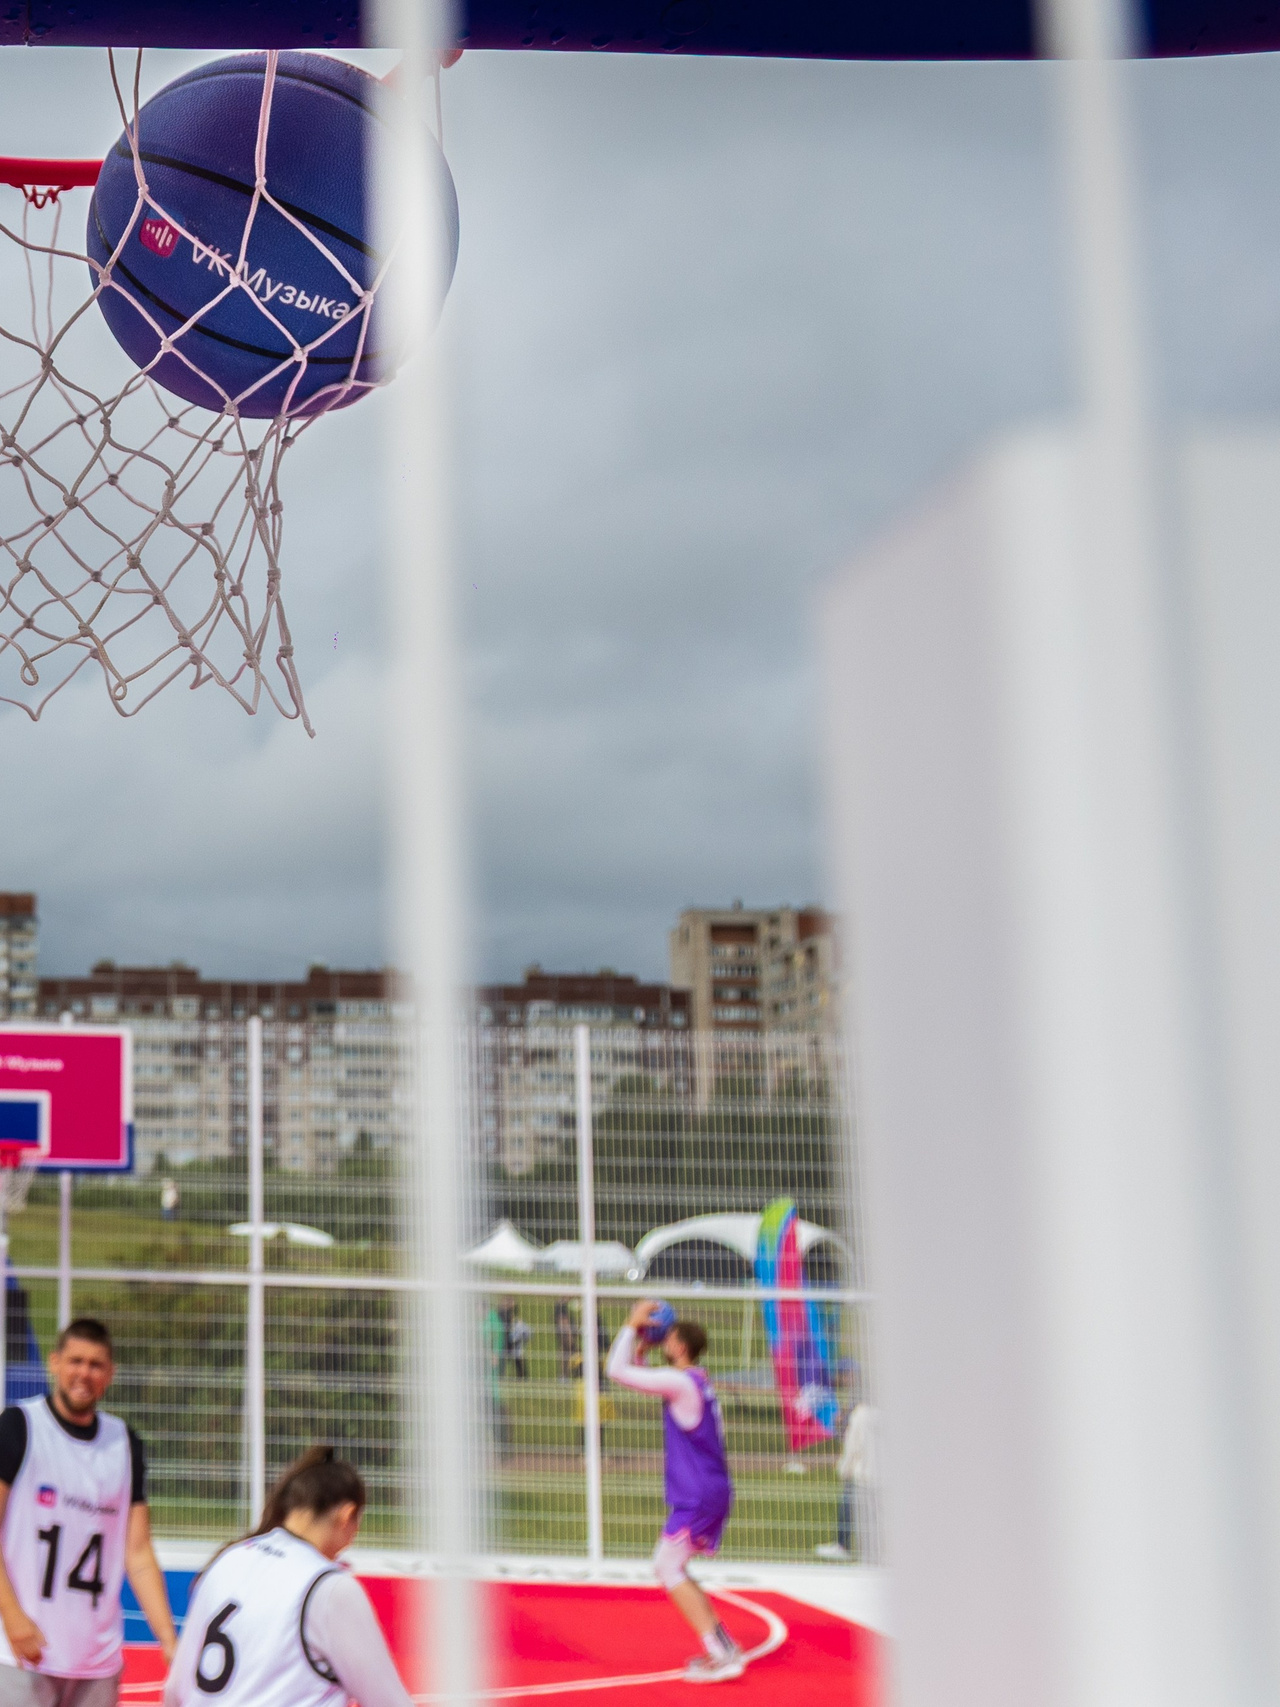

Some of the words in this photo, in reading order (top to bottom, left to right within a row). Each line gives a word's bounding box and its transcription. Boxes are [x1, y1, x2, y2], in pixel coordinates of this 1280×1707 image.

[192, 236, 232, 277] VK
[238, 260, 351, 320] Музыка
[38, 1525, 105, 1609] 14
[196, 1602, 237, 1693] 6
